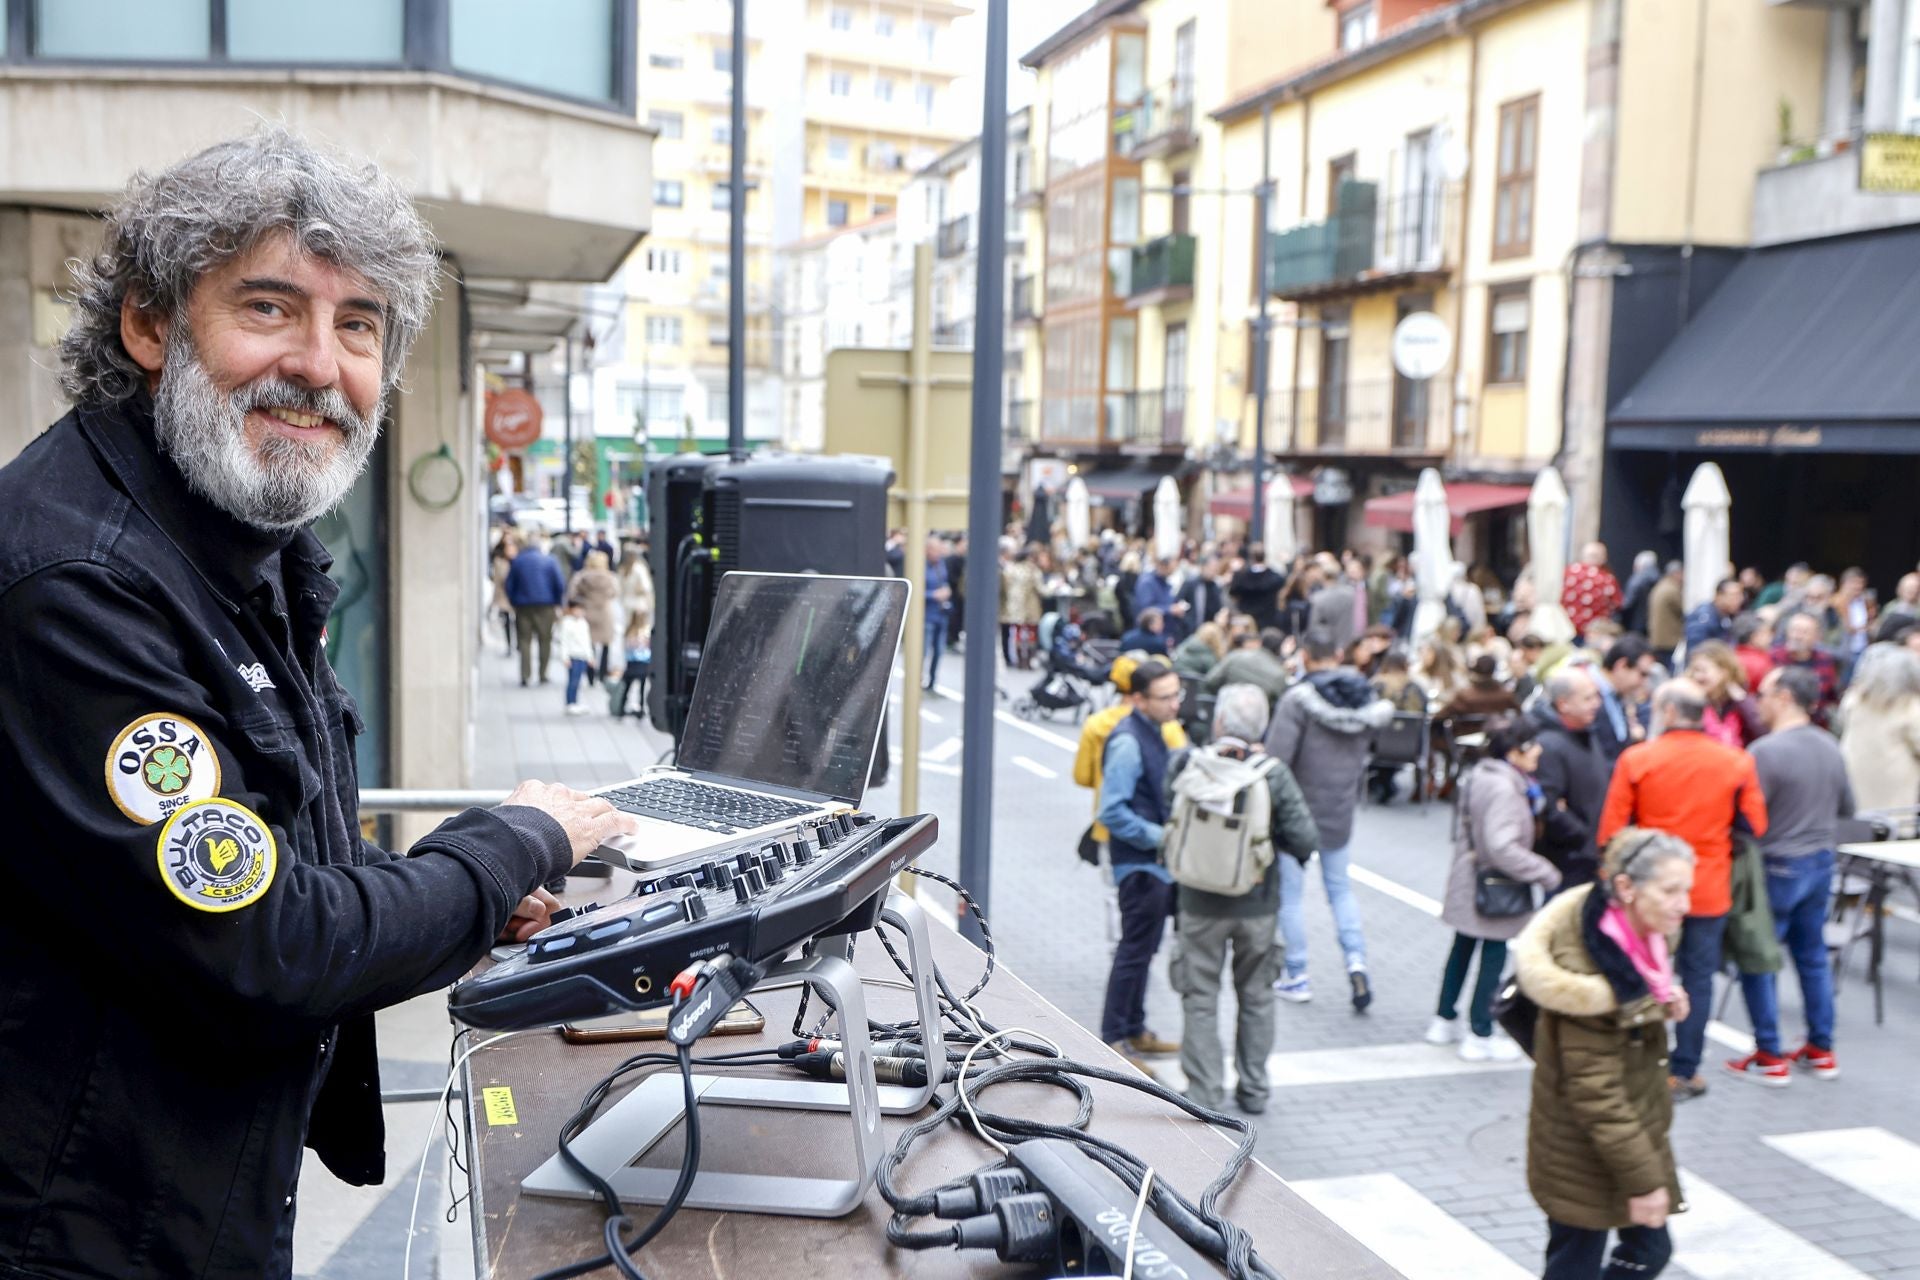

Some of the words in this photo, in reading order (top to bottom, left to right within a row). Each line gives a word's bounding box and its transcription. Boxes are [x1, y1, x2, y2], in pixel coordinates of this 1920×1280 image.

[119, 721, 200, 775] OSSA
[159, 795, 191, 810] SINCE
[169, 808, 262, 890] BULTACO
[212, 860, 262, 896] CEMOTO
[221, 894, 245, 903] MADE
[689, 945, 715, 959] MASTER
[716, 941, 731, 952] OUT
[632, 965, 646, 975] MIC
